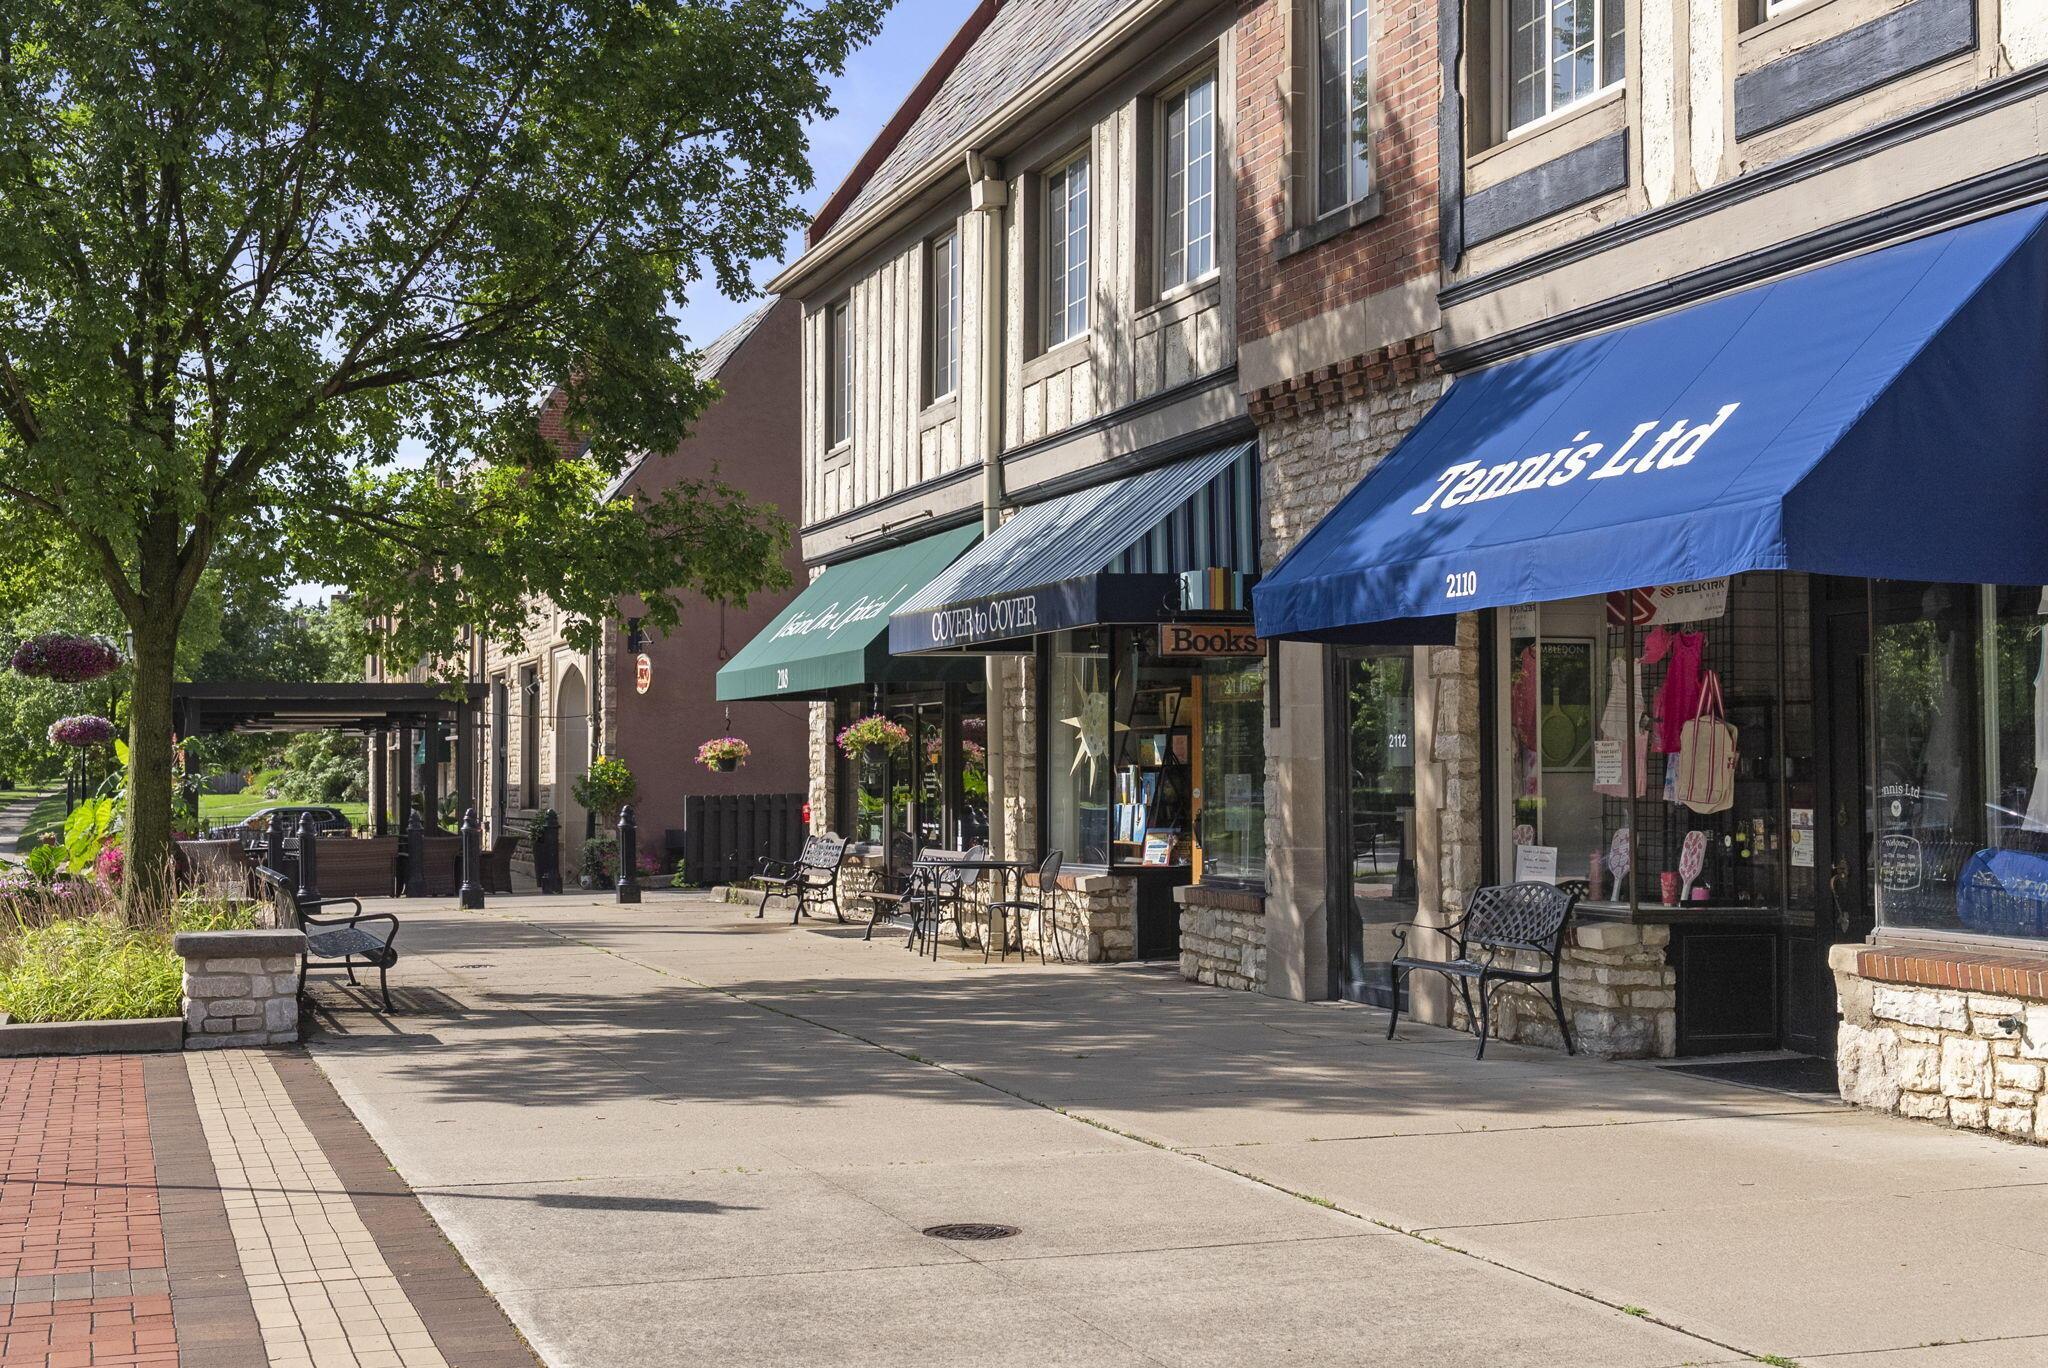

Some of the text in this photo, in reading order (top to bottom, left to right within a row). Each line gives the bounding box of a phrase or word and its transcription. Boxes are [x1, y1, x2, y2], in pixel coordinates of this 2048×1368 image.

[1411, 402, 1741, 515] Tennis Ltd
[1446, 571, 1477, 598] 2110
[1677, 580, 1725, 595] SELKIRK
[932, 595, 1037, 642] COVER to COVER
[1171, 628, 1258, 652] Books
[1541, 644, 1584, 655] MBLEDON
[1389, 734, 1407, 748] 2112
[1881, 782, 1920, 798] nnis Ltd
